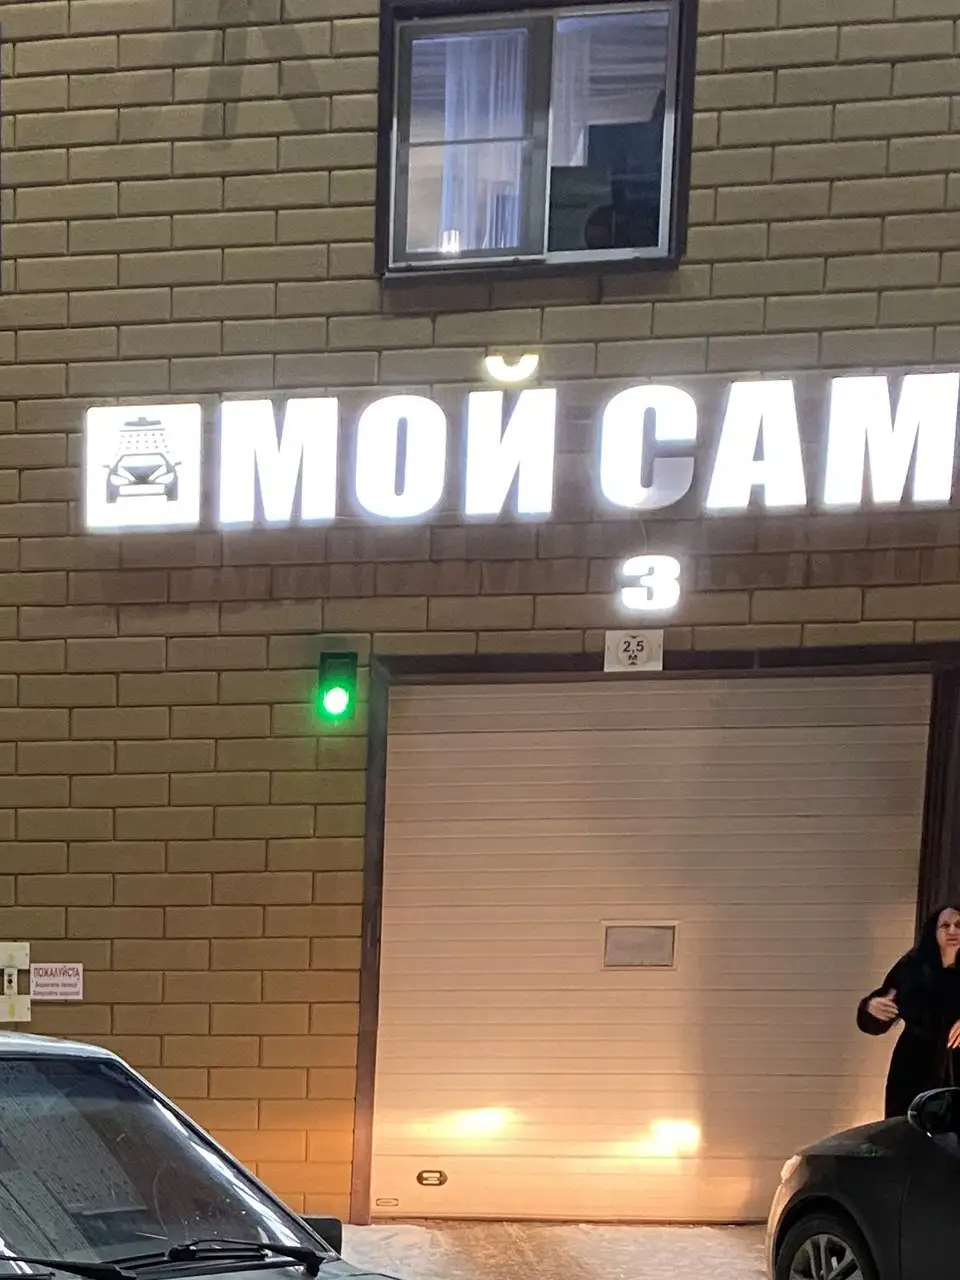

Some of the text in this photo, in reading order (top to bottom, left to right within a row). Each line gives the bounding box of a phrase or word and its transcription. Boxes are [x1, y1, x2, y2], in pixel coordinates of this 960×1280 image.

[219, 354, 960, 522] МОЙ САМ
[621, 554, 681, 611] 3
[622, 640, 645, 655] 2,5
[33, 965, 80, 978] ПОЖАЛУЙСТА
